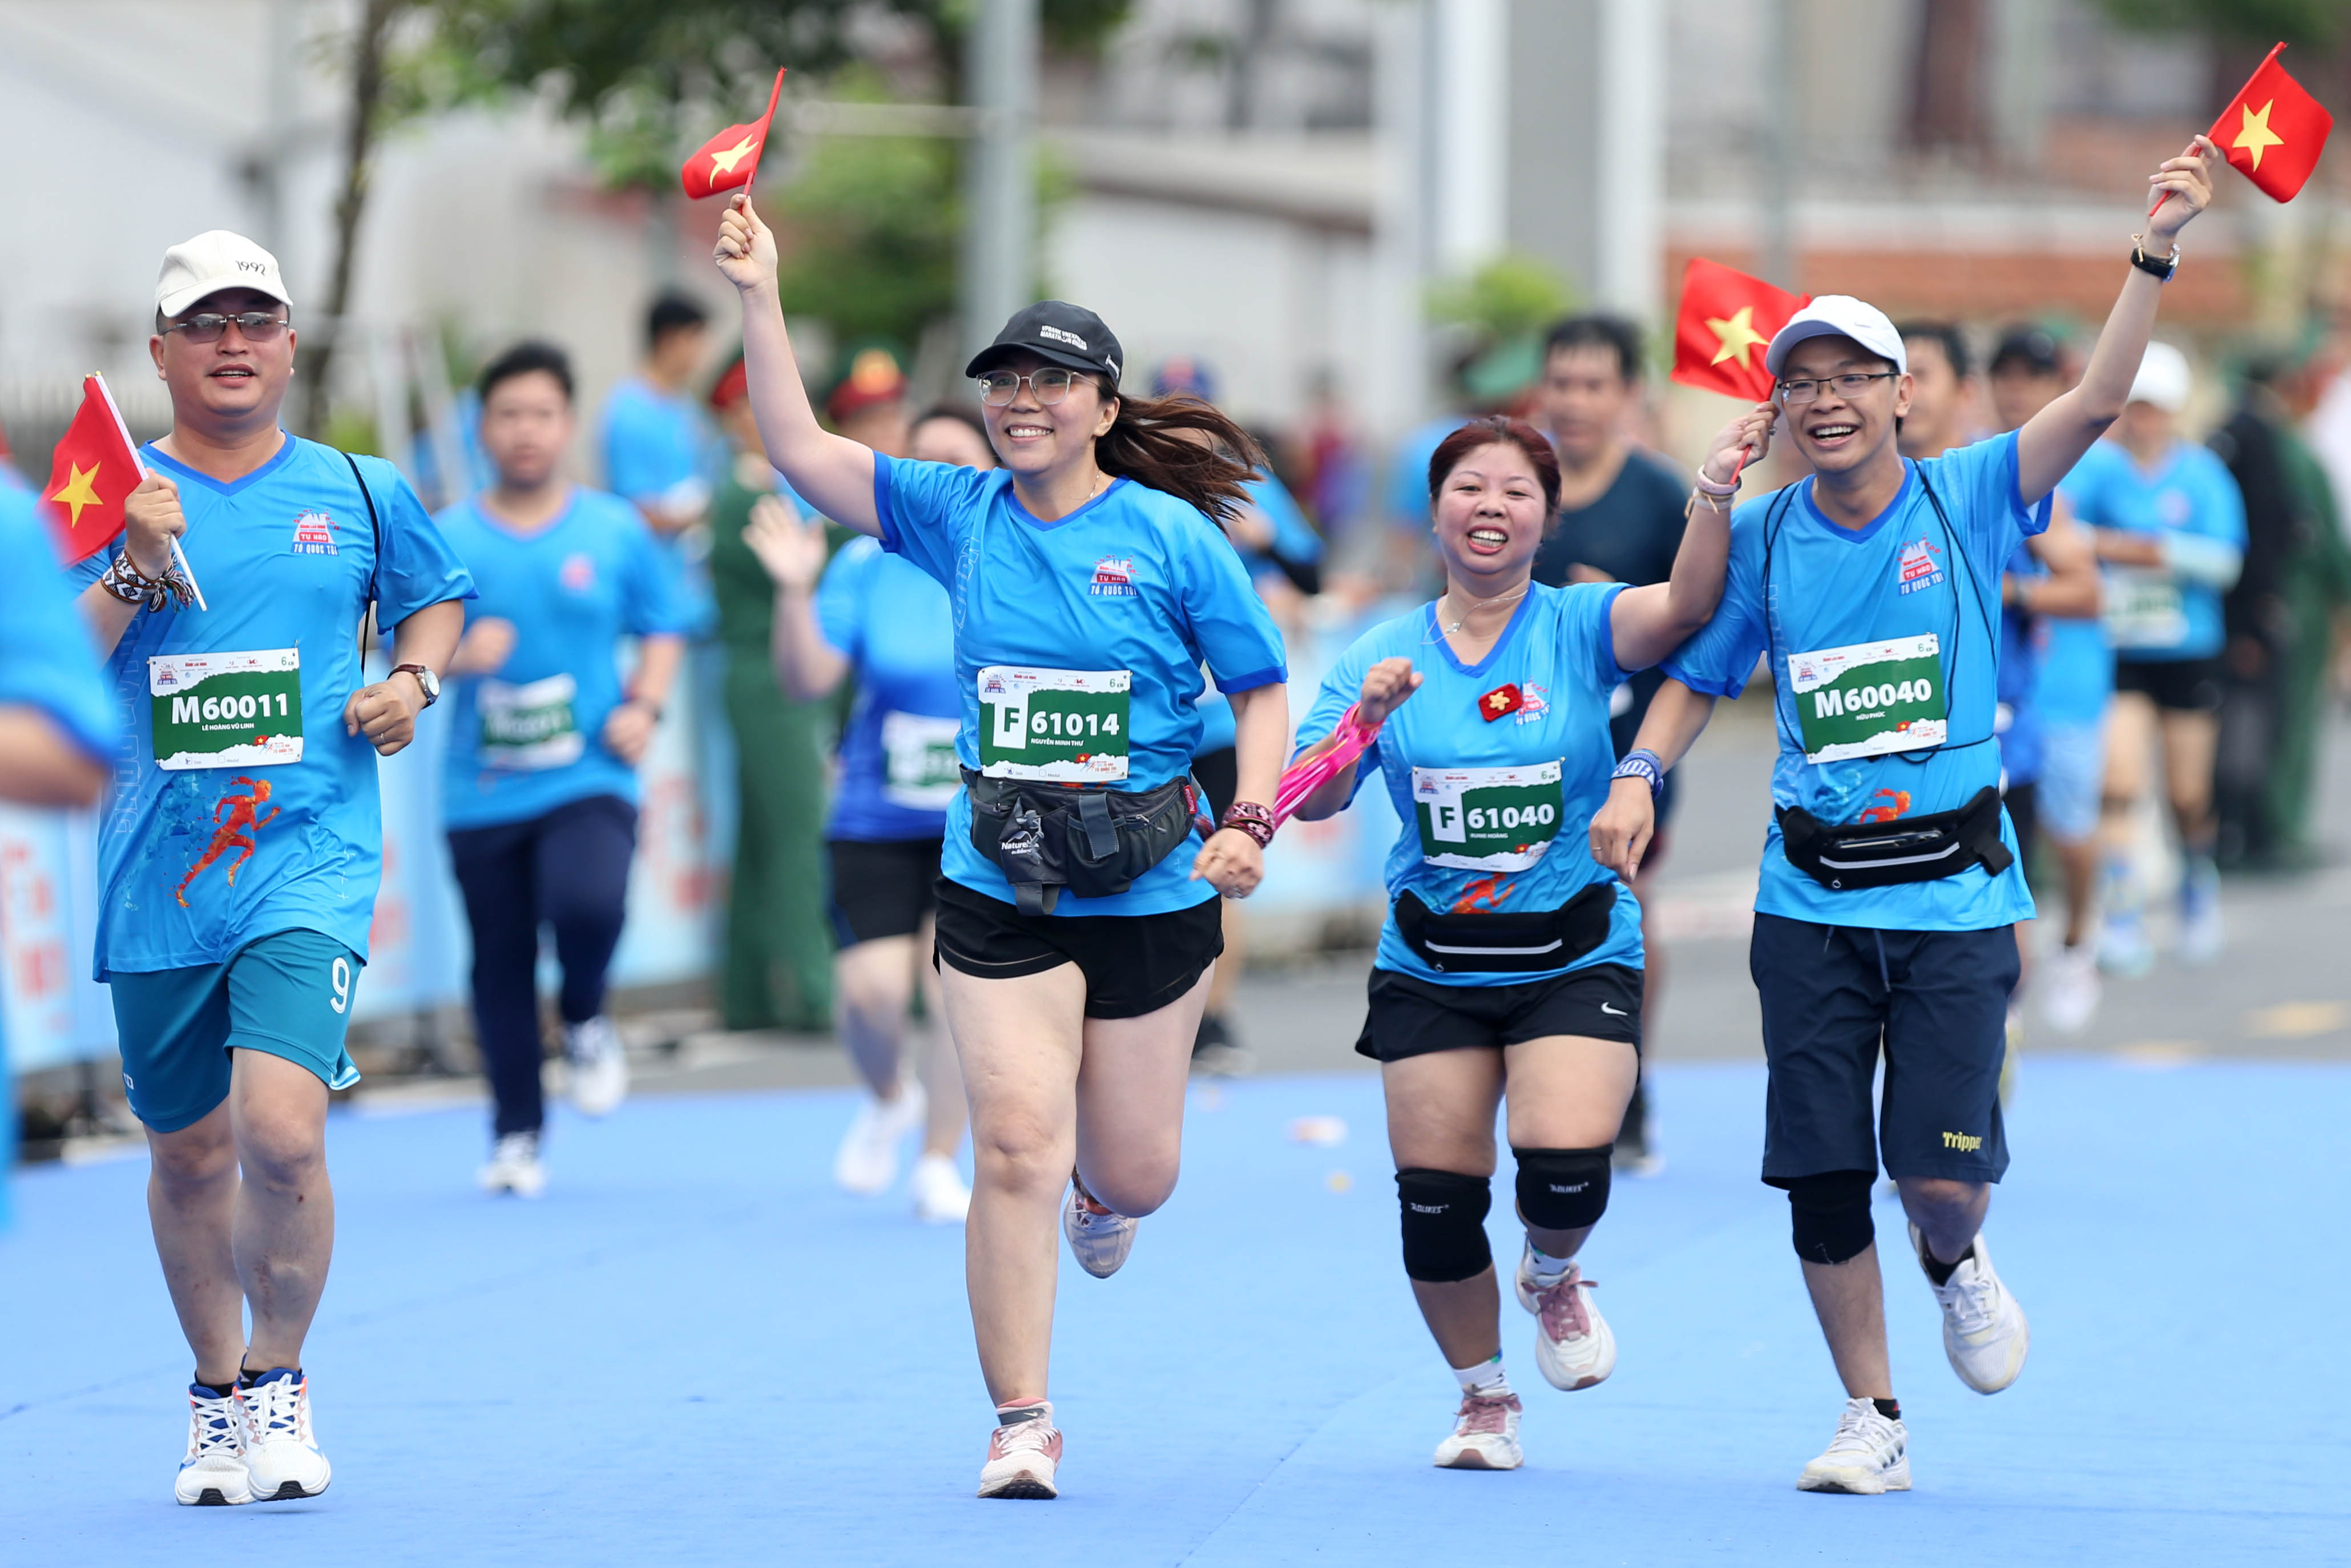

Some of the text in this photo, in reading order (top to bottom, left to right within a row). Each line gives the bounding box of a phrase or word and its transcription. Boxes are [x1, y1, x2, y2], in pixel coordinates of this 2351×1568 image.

[235, 260, 265, 276] 1992
[1040, 330, 1072, 344] MARATHON
[1918, 643, 1924, 652] 6
[281, 656, 287, 666] 6
[1109, 678, 1116, 688] 6
[1814, 678, 1932, 719] M60040
[172, 693, 288, 724] M60011
[1541, 771, 1547, 780] 6
[330, 957, 350, 1014] 9
